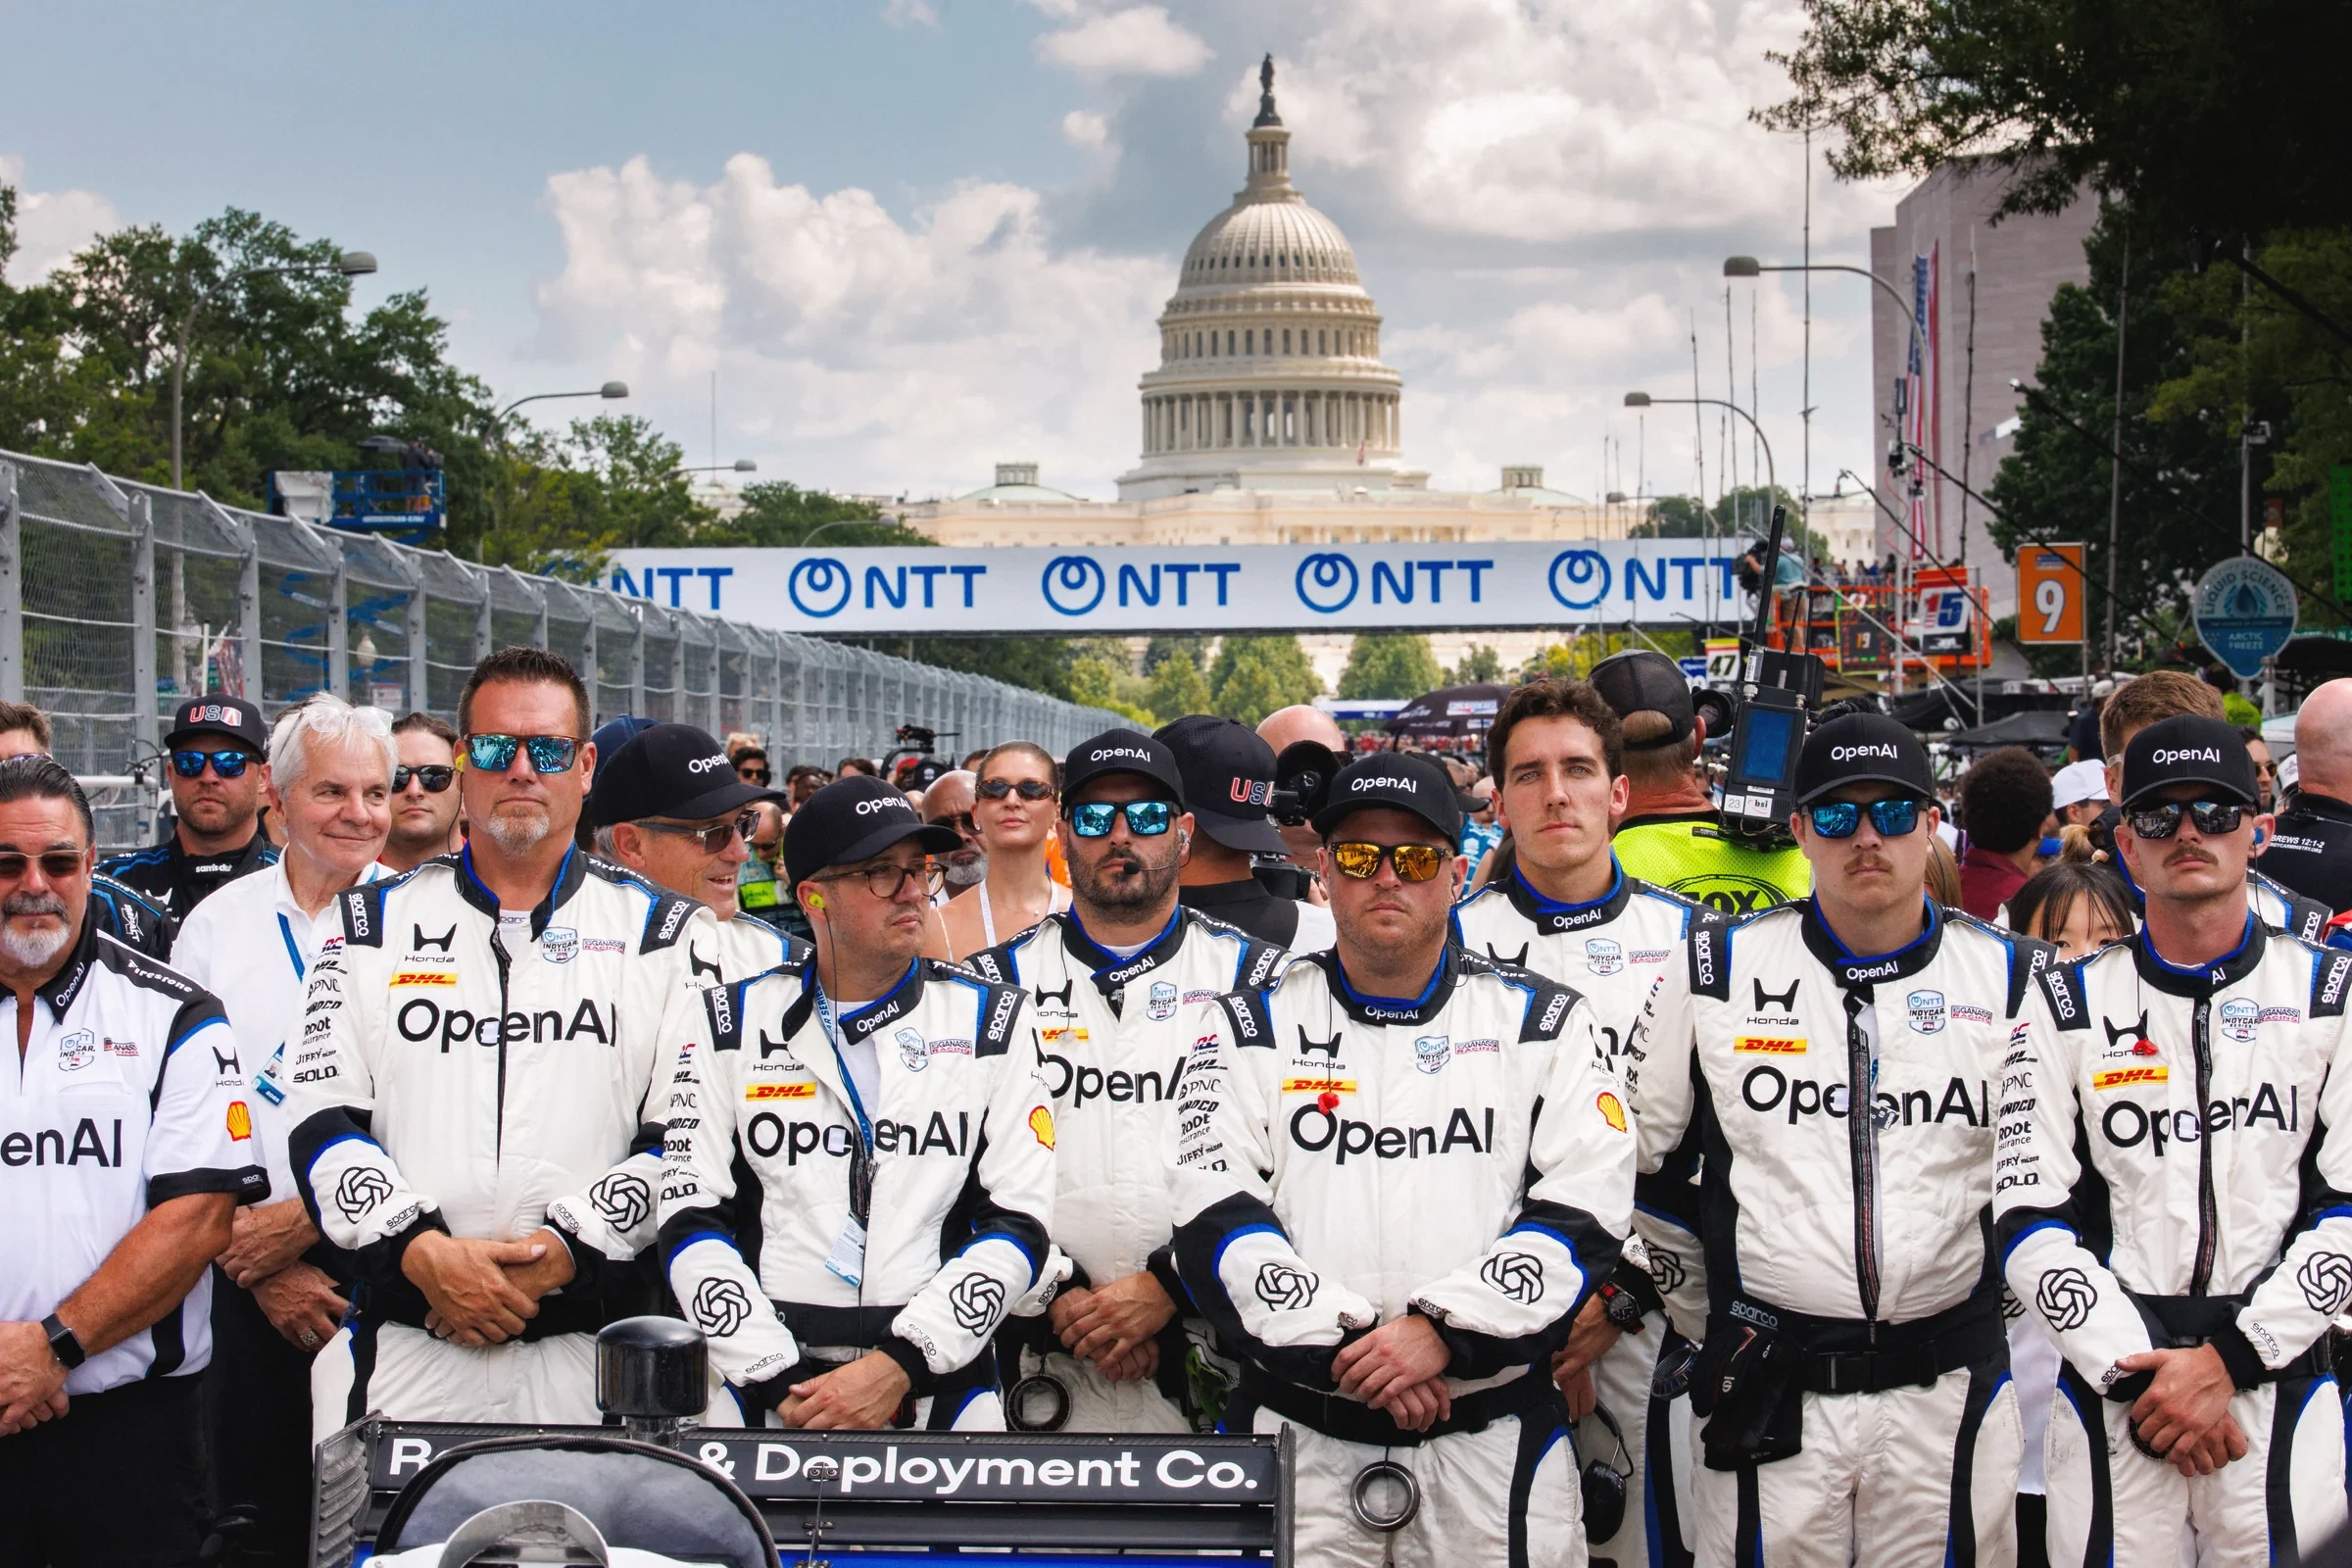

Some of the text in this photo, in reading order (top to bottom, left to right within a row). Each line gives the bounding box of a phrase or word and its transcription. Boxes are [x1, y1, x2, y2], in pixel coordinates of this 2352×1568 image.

[612, 557, 1733, 610] NTT NTT NTT NTT NTT
[2205, 569, 2286, 614] LIQUID SCIENCE
[1924, 592, 1965, 628] 15
[2034, 578, 2066, 634] 9
[2229, 641, 2263, 650] FREEZE
[1708, 654, 1737, 677] 47
[189, 705, 242, 726] USA
[1091, 748, 1152, 762] OpenAI
[1831, 743, 1898, 761] OpenAI
[2152, 748, 2221, 764] OpenAI
[688, 753, 729, 774] Open
[1351, 776, 1417, 794] OpenAI
[856, 797, 912, 814] OpenAI
[1728, 798, 1741, 809] 23
[1753, 798, 1768, 809] bsi
[2271, 834, 2325, 848] BREWS 12:1-2
[349, 893, 368, 938] sparco
[659, 900, 690, 941] sparco
[1553, 908, 1601, 929] OpenAI
[2302, 911, 2322, 941] arco
[543, 940, 577, 950] INDYCAR
[556, 932, 572, 941] NTT
[405, 955, 455, 963] Honda
[1249, 948, 1279, 986] sparco
[1694, 930, 1714, 985] sparco
[127, 958, 193, 994] Firestone
[398, 973, 449, 984] DHL
[1109, 956, 1155, 982] OpenAI
[1846, 960, 1899, 982] OpenAI
[2212, 967, 2227, 985] AI
[55, 961, 85, 1007] OpenAI
[2322, 956, 2352, 1004] sparco
[1923, 997, 1940, 1005] NTT
[2045, 970, 2076, 1020] sparco
[711, 986, 733, 1035] sparco
[856, 1000, 900, 1033] OpenAI
[988, 991, 1017, 1043] sparco
[1227, 996, 1258, 1038] sparco
[1365, 1004, 1419, 1020] OpenAI
[1540, 994, 1570, 1032] sparco
[1746, 1016, 1799, 1026] Honda
[1909, 1008, 1945, 1017] INDYCAR
[1417, 1047, 1450, 1061] INDYCAR
[1430, 1040, 1447, 1052] NTT
[1743, 1040, 1798, 1052] DHL
[2102, 1050, 2145, 1059] Hon
[293, 1065, 339, 1083] SOLO
[753, 1063, 805, 1072] Honda
[1292, 1058, 1346, 1070] Honda
[1190, 1078, 1221, 1095] PNC
[1294, 1080, 1347, 1091] DHL
[2006, 1072, 2033, 1093] PNC
[2103, 1069, 2160, 1085] DHL
[756, 1086, 808, 1098] DHL
[1, 1117, 122, 1167] enAI
[1179, 1126, 1211, 1148] nsurance
[1290, 1103, 1494, 1165] OpenAI
[1998, 1135, 2032, 1151] nsurance
[1177, 1144, 1204, 1166] JIFFY
[1995, 1172, 2038, 1196] SOLO
[1730, 1299, 1779, 1331] sparco
[2250, 1321, 2280, 1359] sparco
[745, 1352, 785, 1374] sparco
[2101, 1361, 2123, 1384] spa
[389, 1438, 1258, 1494] R & Deployment Co.
